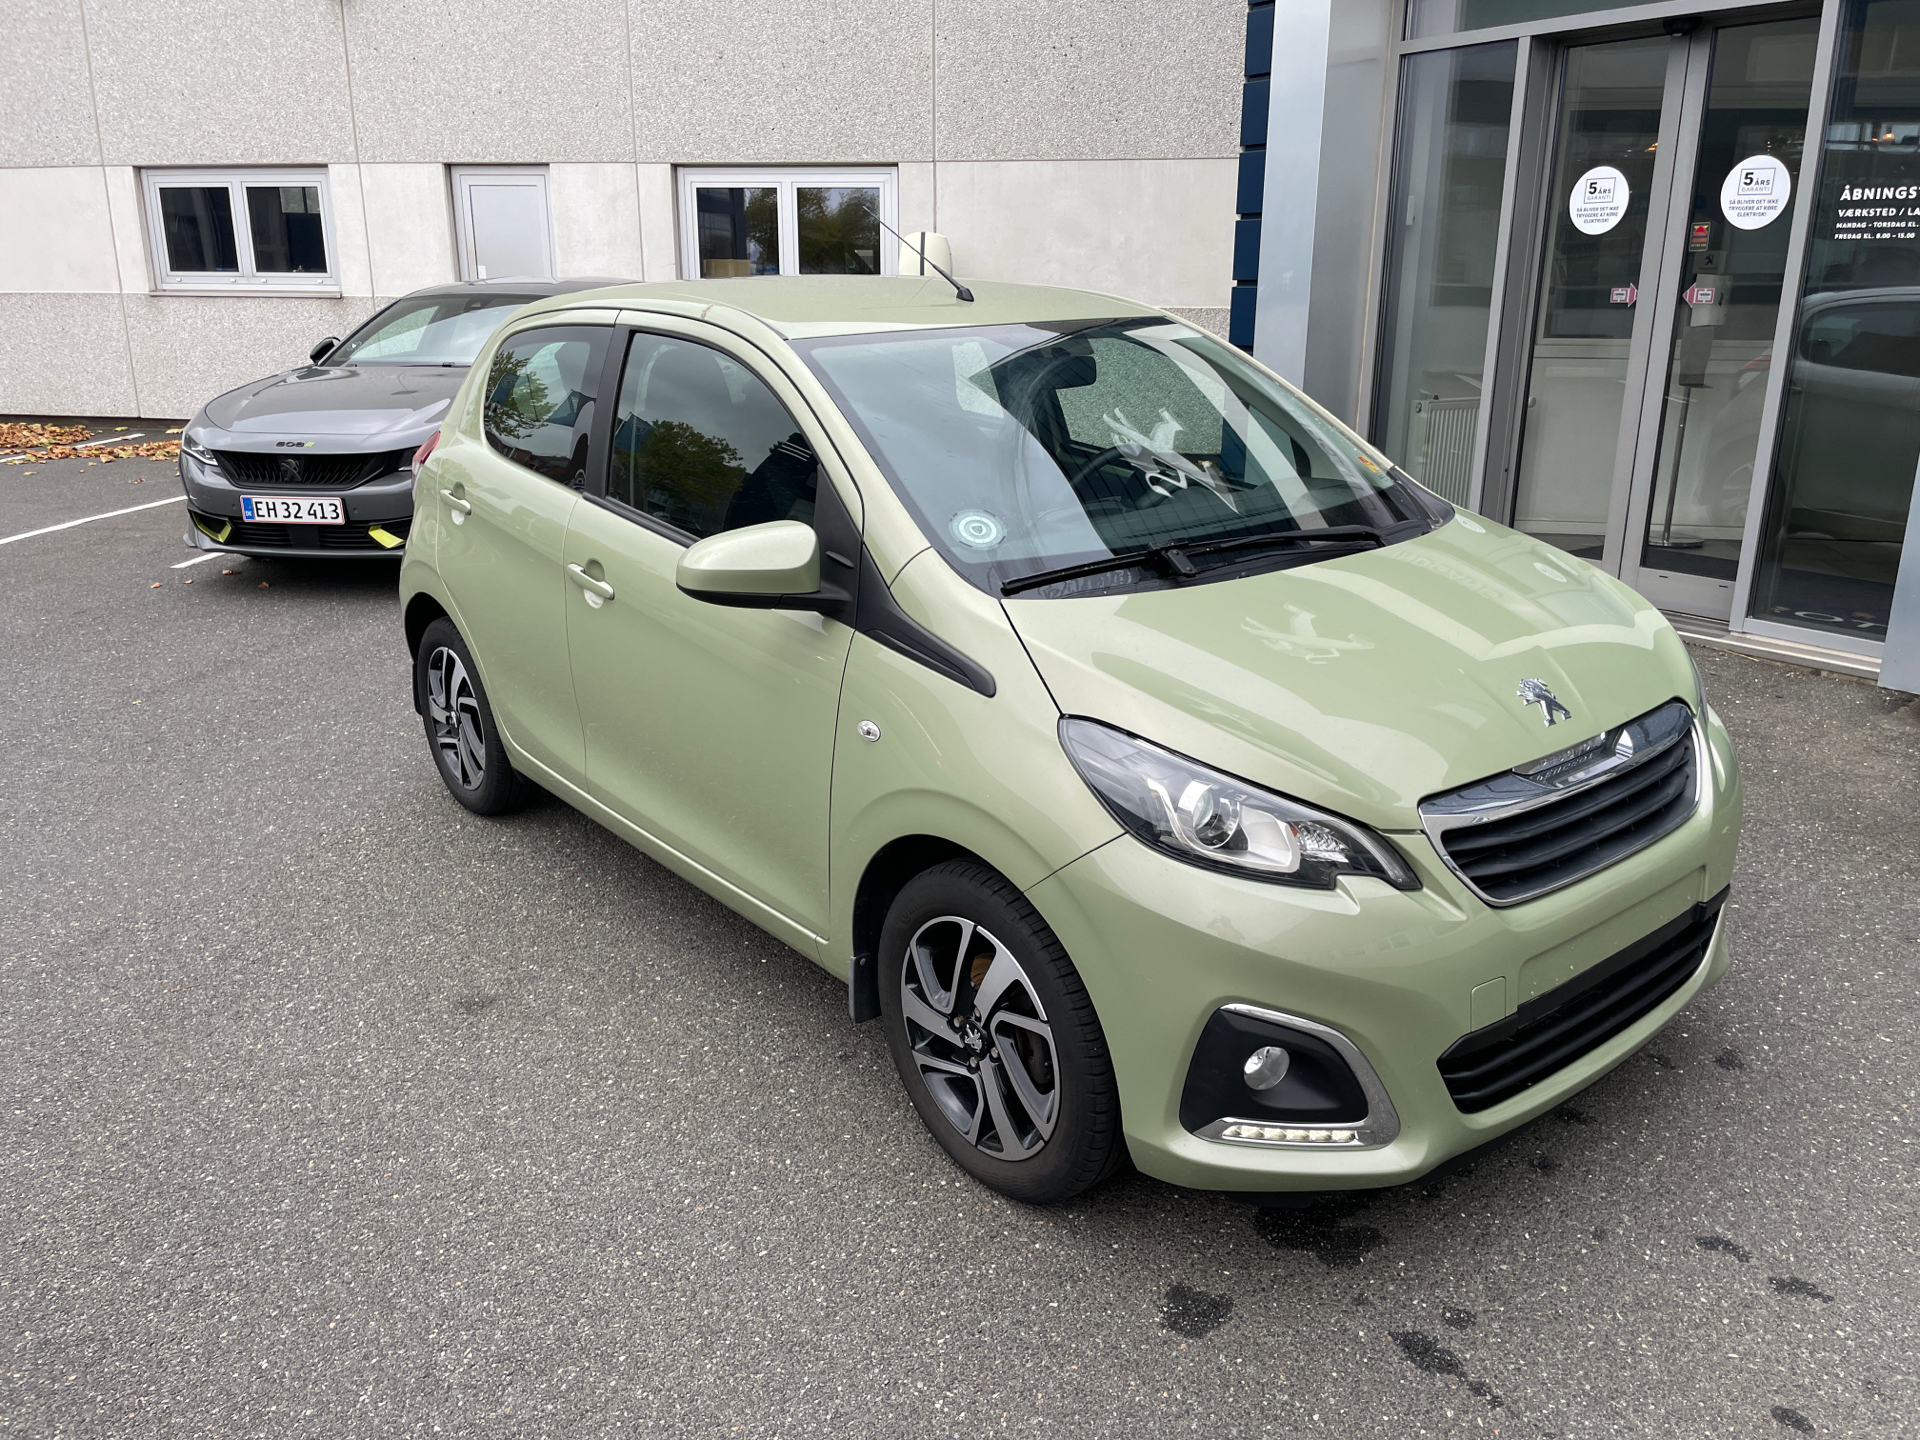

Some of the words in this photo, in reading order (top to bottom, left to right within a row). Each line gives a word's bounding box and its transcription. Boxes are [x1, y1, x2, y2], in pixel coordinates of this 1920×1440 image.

[1743, 172, 1754, 186] 5
[1754, 178, 1770, 186] ÅRS
[1588, 182, 1597, 194] 5
[1840, 185, 1920, 200] ÅBNINGS
[1838, 207, 1897, 217] VÆRKSTED
[254, 501, 278, 518] EH
[280, 501, 303, 519] 32
[307, 502, 340, 520] 413
